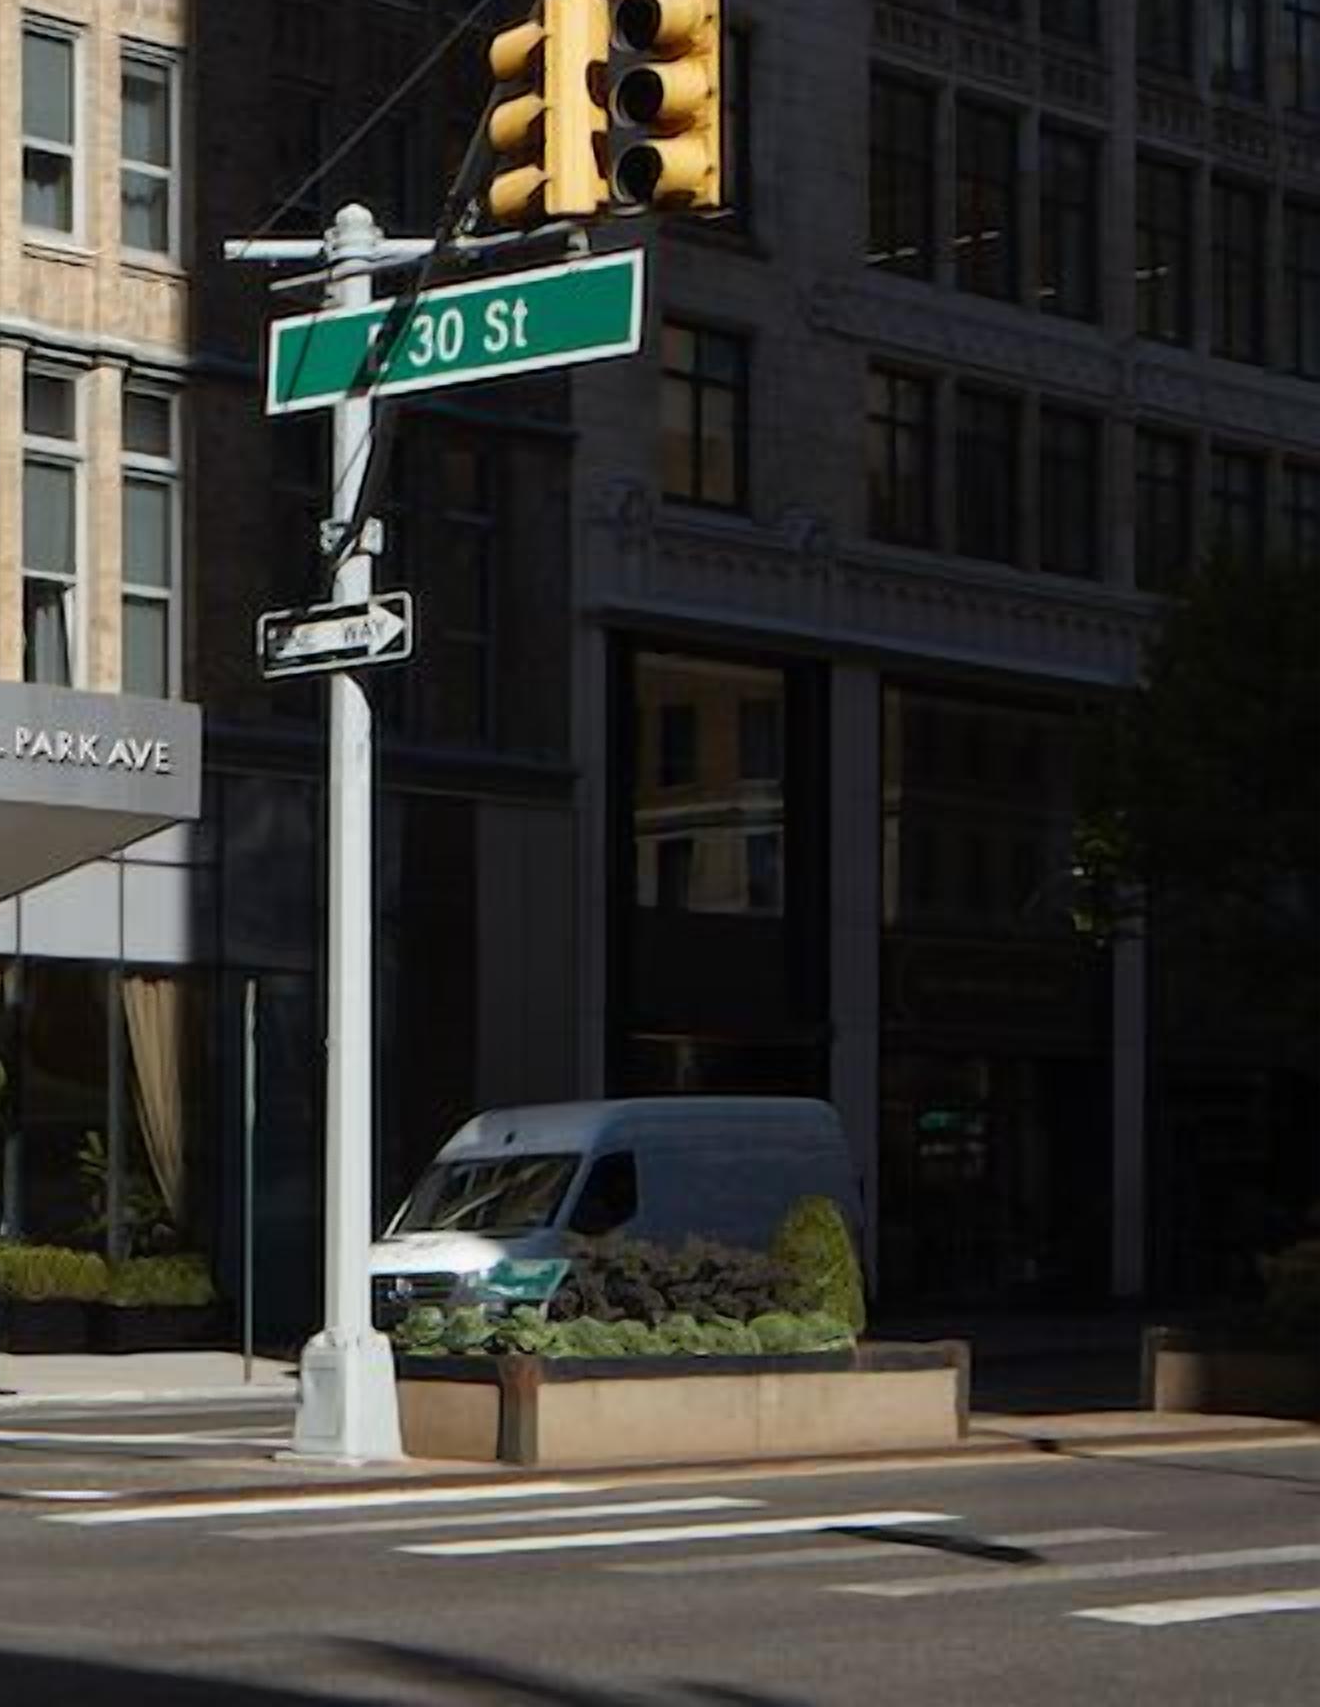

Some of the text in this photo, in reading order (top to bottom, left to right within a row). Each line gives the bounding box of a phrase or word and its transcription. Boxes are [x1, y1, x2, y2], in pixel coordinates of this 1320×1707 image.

[408, 307, 464, 367] 30
[483, 297, 529, 353] St
[15, 726, 101, 767] PARK
[107, 737, 173, 775] AVE
